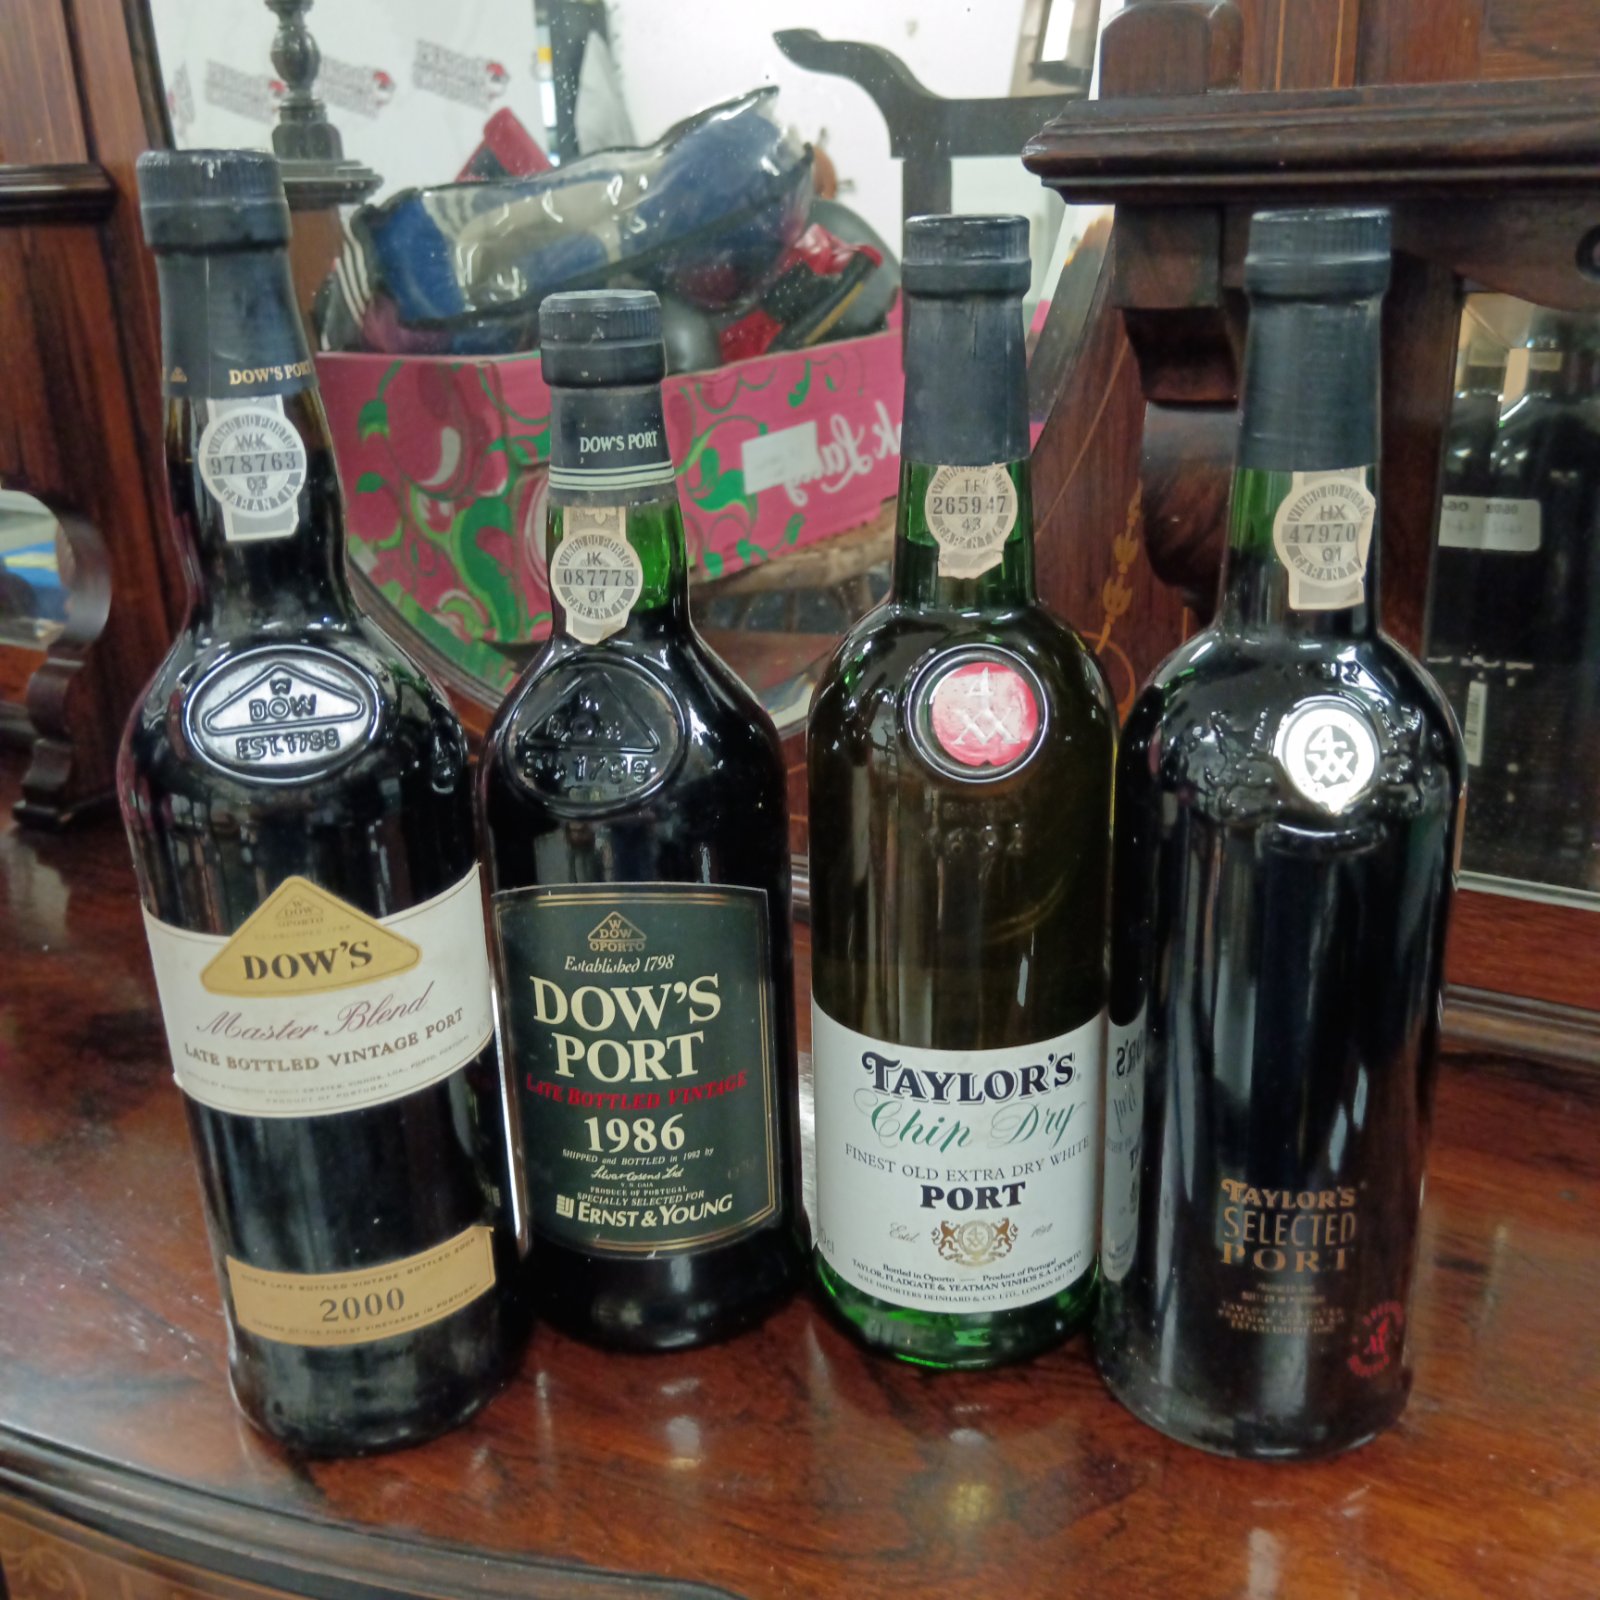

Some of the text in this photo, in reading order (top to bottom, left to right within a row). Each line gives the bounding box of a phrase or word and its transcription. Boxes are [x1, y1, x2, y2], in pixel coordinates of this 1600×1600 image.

[229, 366, 284, 385] DOW'S
[580, 431, 657, 453] DOW'S PORT
[211, 451, 296, 475] 978763
[1320, 504, 1347, 521] HX
[586, 552, 603, 566] IK
[1321, 547, 1342, 562] 01
[563, 568, 635, 586] 087778
[588, 590, 606, 603] 01
[249, 694, 317, 723] DOW
[599, 928, 632, 939] DOW
[608, 919, 622, 929] W
[242, 940, 373, 981] DOW'S
[590, 942, 646, 953] OPORTO
[564, 954, 675, 974] Established 1798
[196, 980, 436, 1041] Master Blend
[529, 972, 722, 1033] DOW'S
[184, 1007, 465, 1073] LATE BOTTLED VINTAGE PORT
[551, 1031, 704, 1084] PORT
[526, 1069, 748, 1111] LATE BOTTLED VINTAGE
[862, 1051, 1076, 1105] TAYLOR'S
[584, 1113, 685, 1154] 1986
[854, 1088, 973, 1153] Chip
[988, 1101, 1088, 1149] Dry
[562, 1148, 598, 1163] SHIPPED
[602, 1157, 617, 1165] and
[621, 1155, 665, 1166] BOTTLED
[670, 1154, 678, 1163] in
[845, 1135, 1090, 1182] FINEST OLD EXTRA DRY WHITE
[577, 1190, 705, 1207] SPECIALLY SELECTED FOR
[643, 1185, 688, 1196] PORTUGAL
[920, 1181, 1026, 1211] PORT
[1220, 1178, 1357, 1210] TAYLOR'S
[578, 1193, 733, 1228] ERNST & YOUNG
[1223, 1207, 1357, 1247] SELECTED
[883, 1263, 912, 1277] Bottled
[923, 1273, 955, 1284] Oporto
[982, 1271, 1015, 1282] Product
[1017, 1267, 1027, 1277] of
[1027, 1258, 1057, 1275] Portugal
[1221, 1242, 1348, 1273] PORT
[852, 1258, 884, 1279] TAYLOR,
[885, 1274, 936, 1290] FLADGATE
[937, 1283, 946, 1292] &
[949, 1282, 999, 1293] YEATMAN
[1001, 1274, 1037, 1288] VINHOS
[876, 1281, 922, 1299] IMPORTERS
[319, 1287, 405, 1323] 2000
